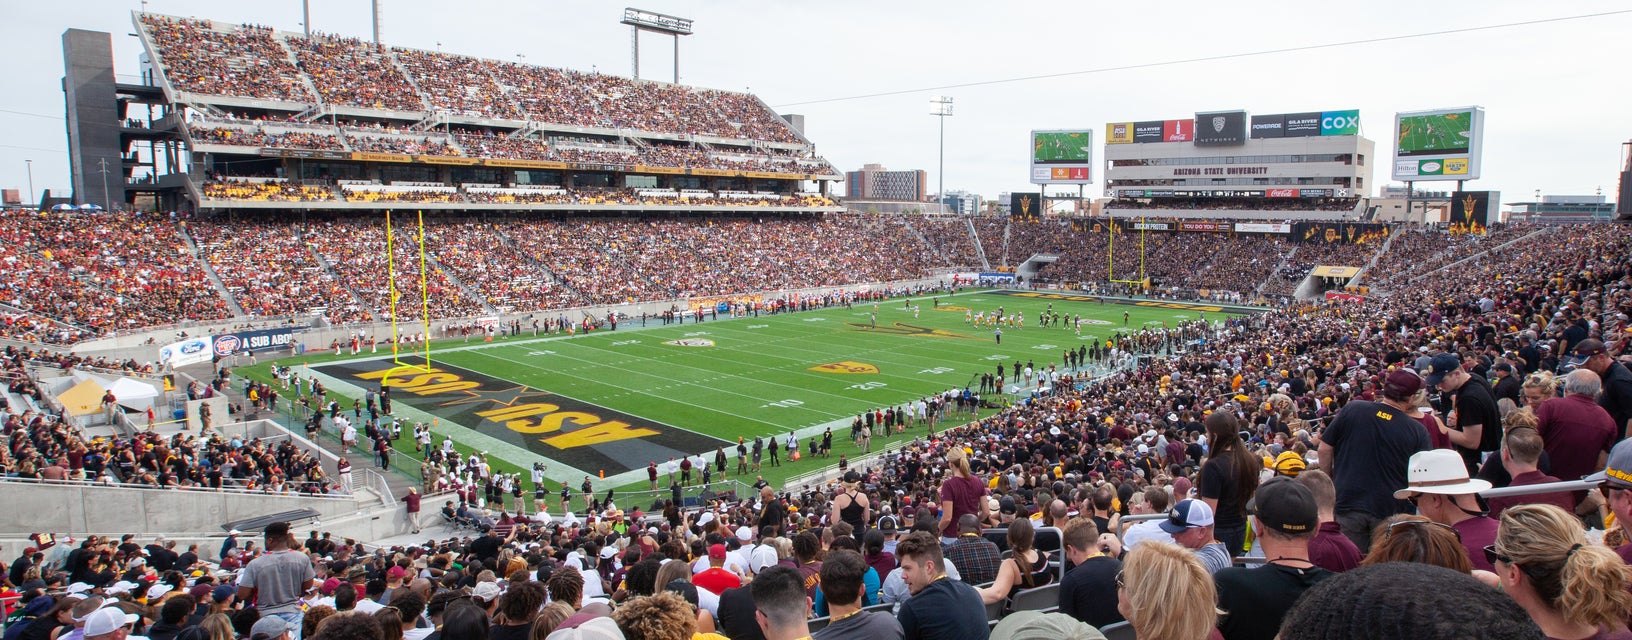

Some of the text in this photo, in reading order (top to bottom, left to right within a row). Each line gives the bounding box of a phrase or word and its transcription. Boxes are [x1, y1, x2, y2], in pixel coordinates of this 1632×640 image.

[1322, 116, 1358, 130] COX
[1204, 167, 1223, 175] STATE
[1226, 167, 1268, 175] UNIVERSITY
[1270, 189, 1293, 197] Coca-Cola
[242, 337, 250, 348] A
[250, 335, 270, 347] SUB
[851, 381, 888, 390] 20
[769, 399, 804, 408] 10
[1278, 399, 1290, 410] 42
[1376, 410, 1393, 421] ASU
[804, 575, 817, 589] SUN
